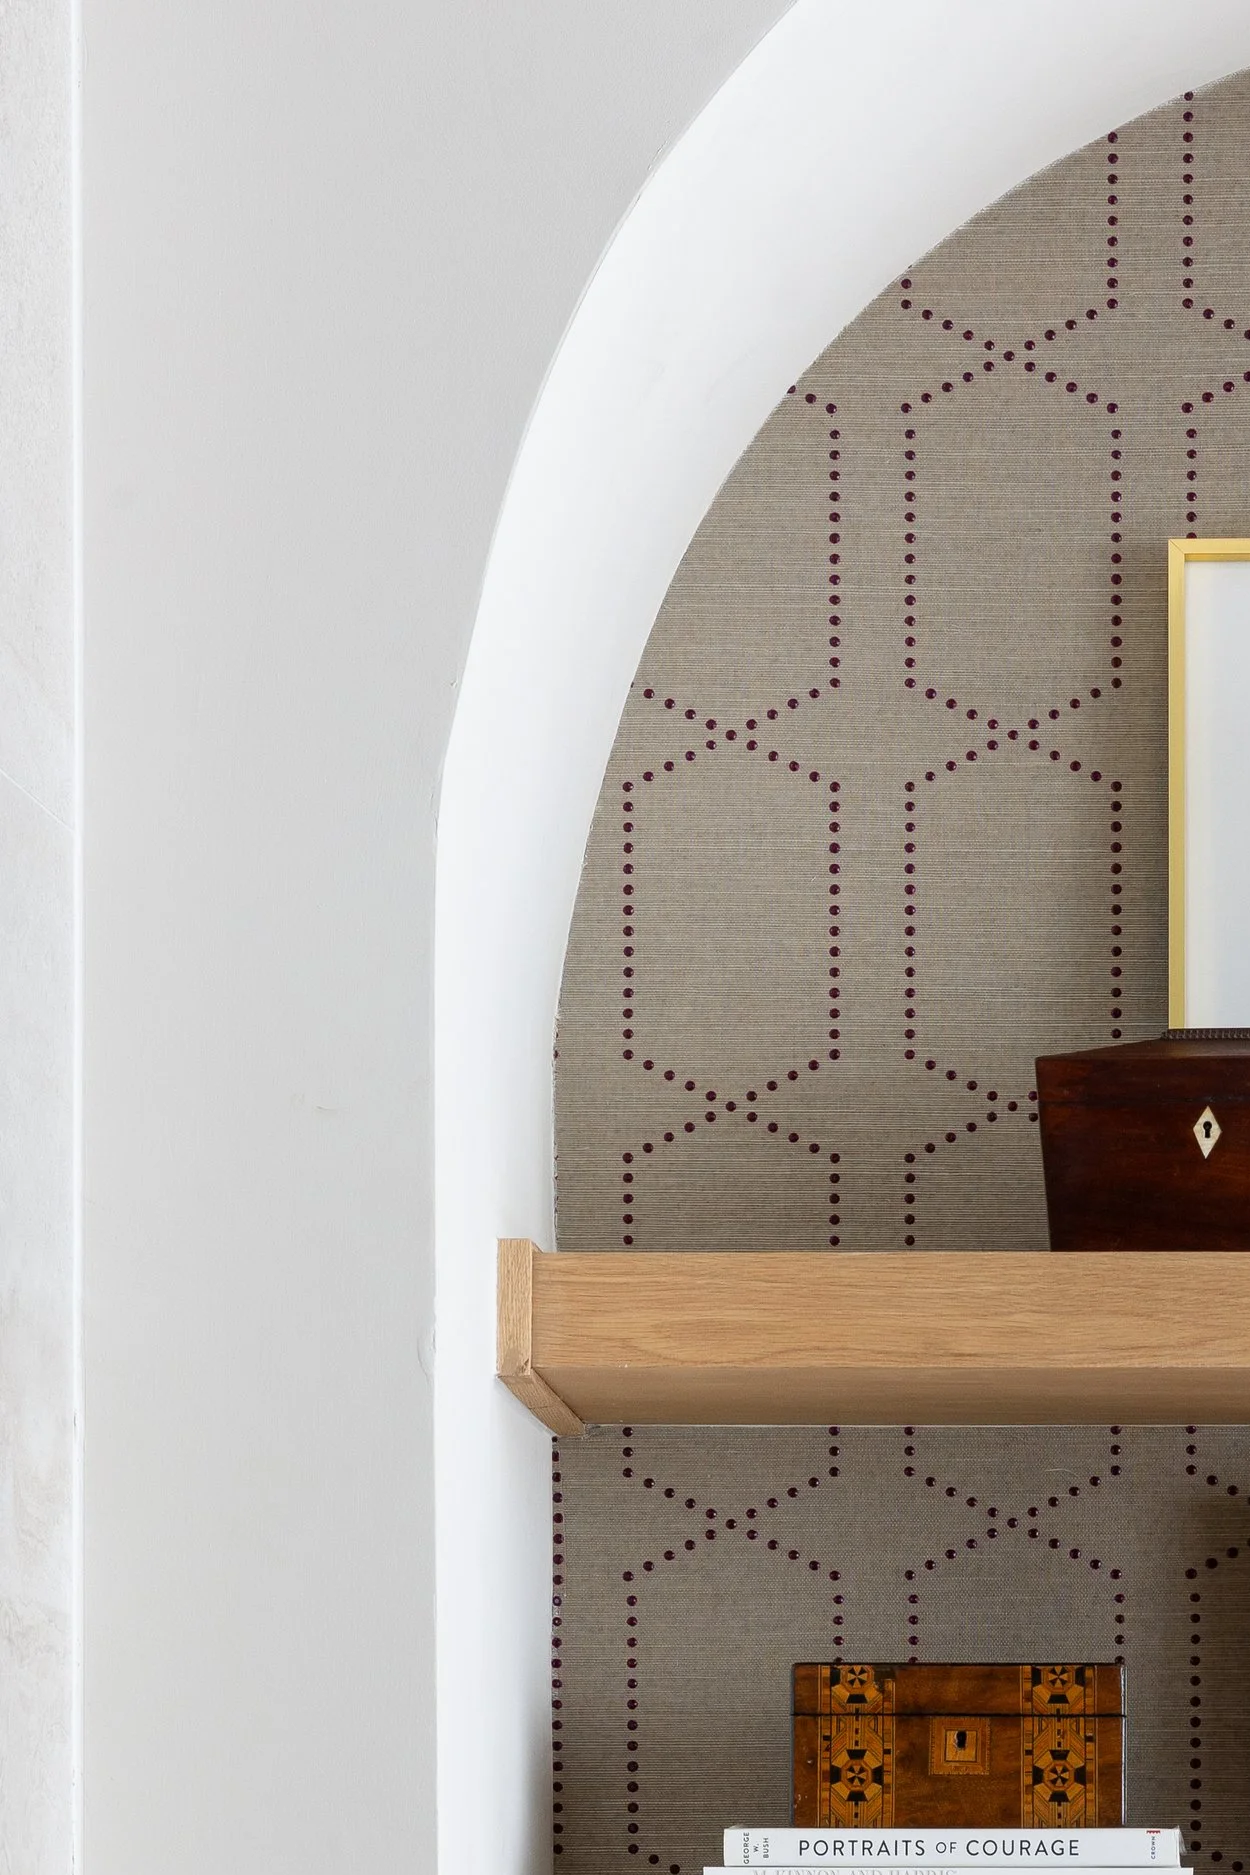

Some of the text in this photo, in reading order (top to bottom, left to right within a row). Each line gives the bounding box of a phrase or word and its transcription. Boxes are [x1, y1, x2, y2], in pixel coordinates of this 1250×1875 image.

[753, 1843, 760, 1853] W.
[762, 1837, 770, 1859] BUSH
[799, 1839, 1080, 1856] PORTRAITS OF COURAGE
